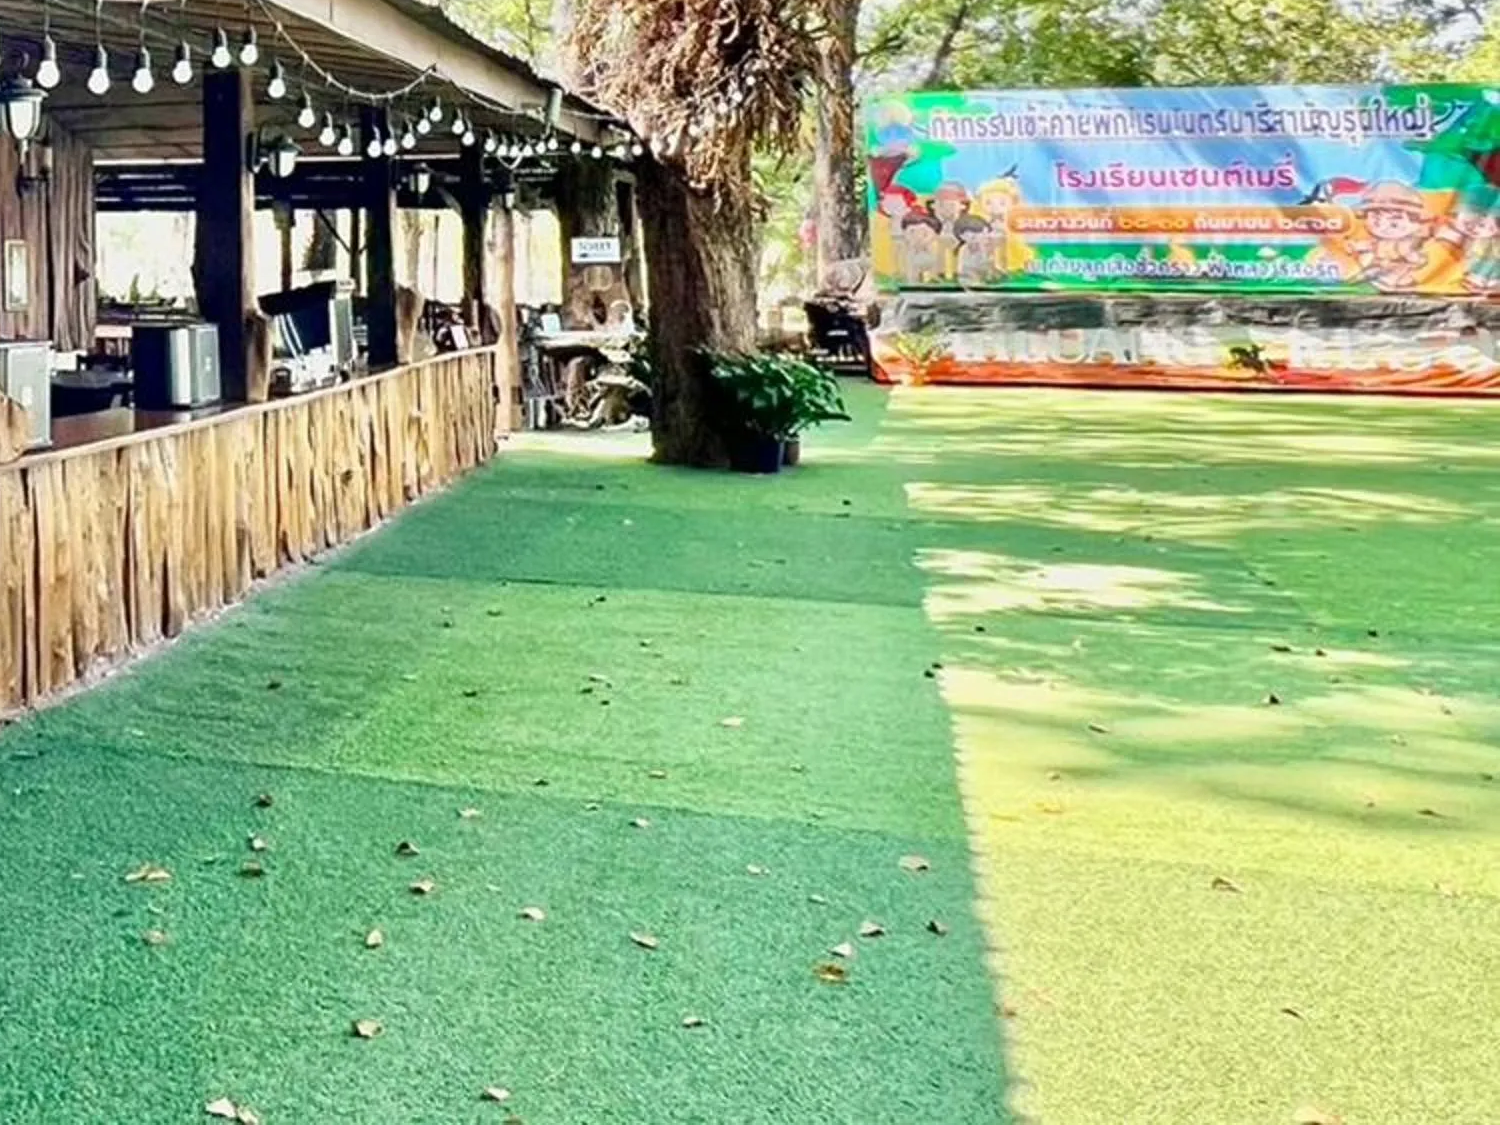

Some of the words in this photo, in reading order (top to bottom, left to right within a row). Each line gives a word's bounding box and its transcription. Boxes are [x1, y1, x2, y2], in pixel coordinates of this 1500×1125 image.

[1055, 152, 1296, 189] โรงเรียนเซนต์เมรี่
